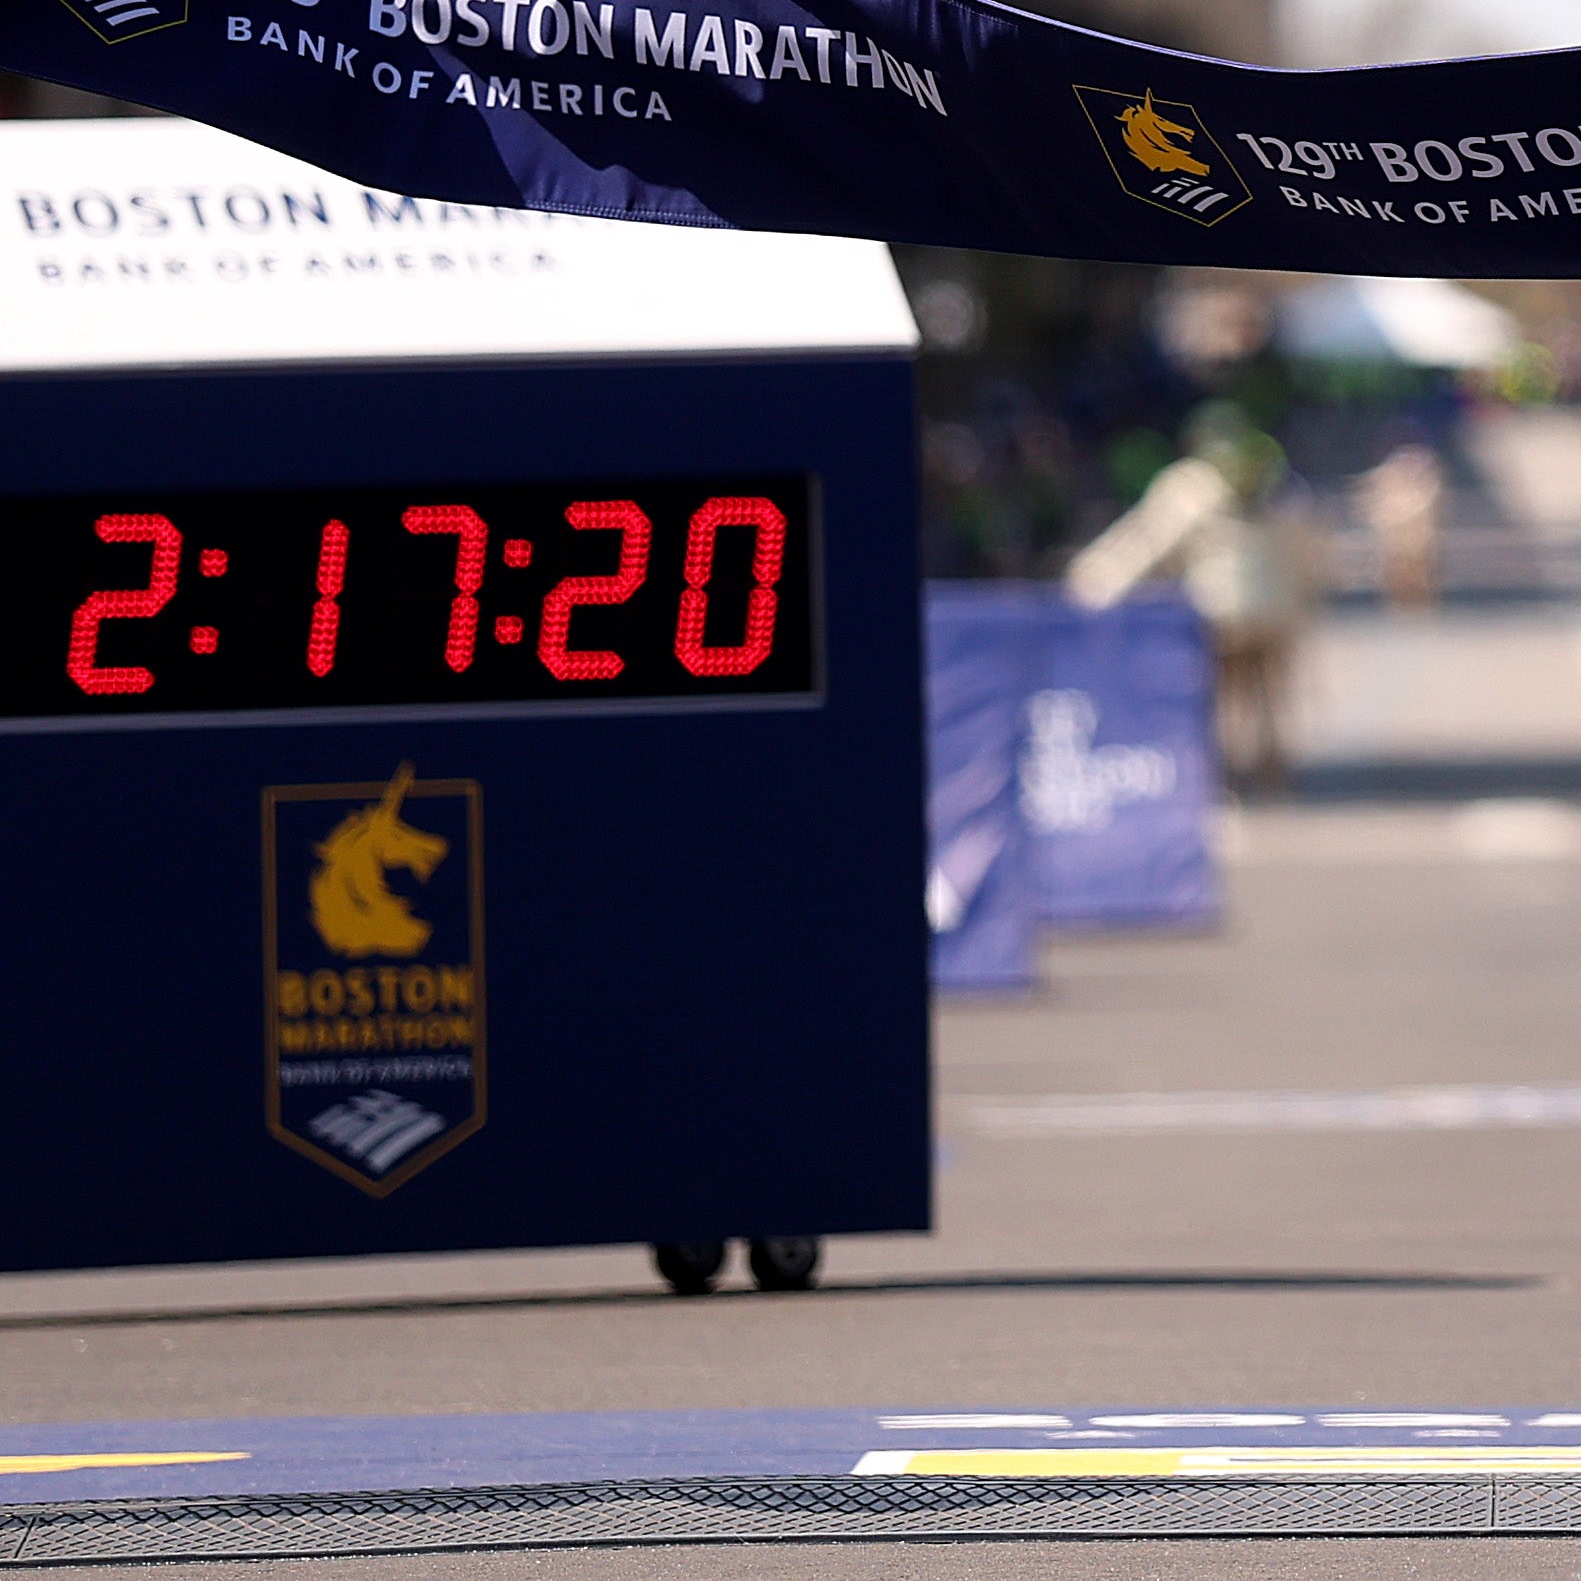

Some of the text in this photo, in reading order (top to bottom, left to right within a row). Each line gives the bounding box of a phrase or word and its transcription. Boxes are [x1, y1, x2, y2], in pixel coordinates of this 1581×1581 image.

[227, 16, 673, 122] BANK OF AMERICA
[634, 7, 948, 117] MARATHON
[1235, 132, 1364, 180] 129TH
[16, 187, 332, 236] BOSTON
[1278, 185, 1406, 223] BANK
[1413, 200, 1470, 224] OF
[37, 245, 562, 285] BANK OF AMERICA
[67, 497, 786, 695] 2:17:20
[278, 966, 476, 1017] BOSTON
[280, 1016, 475, 1053] MARATHON
